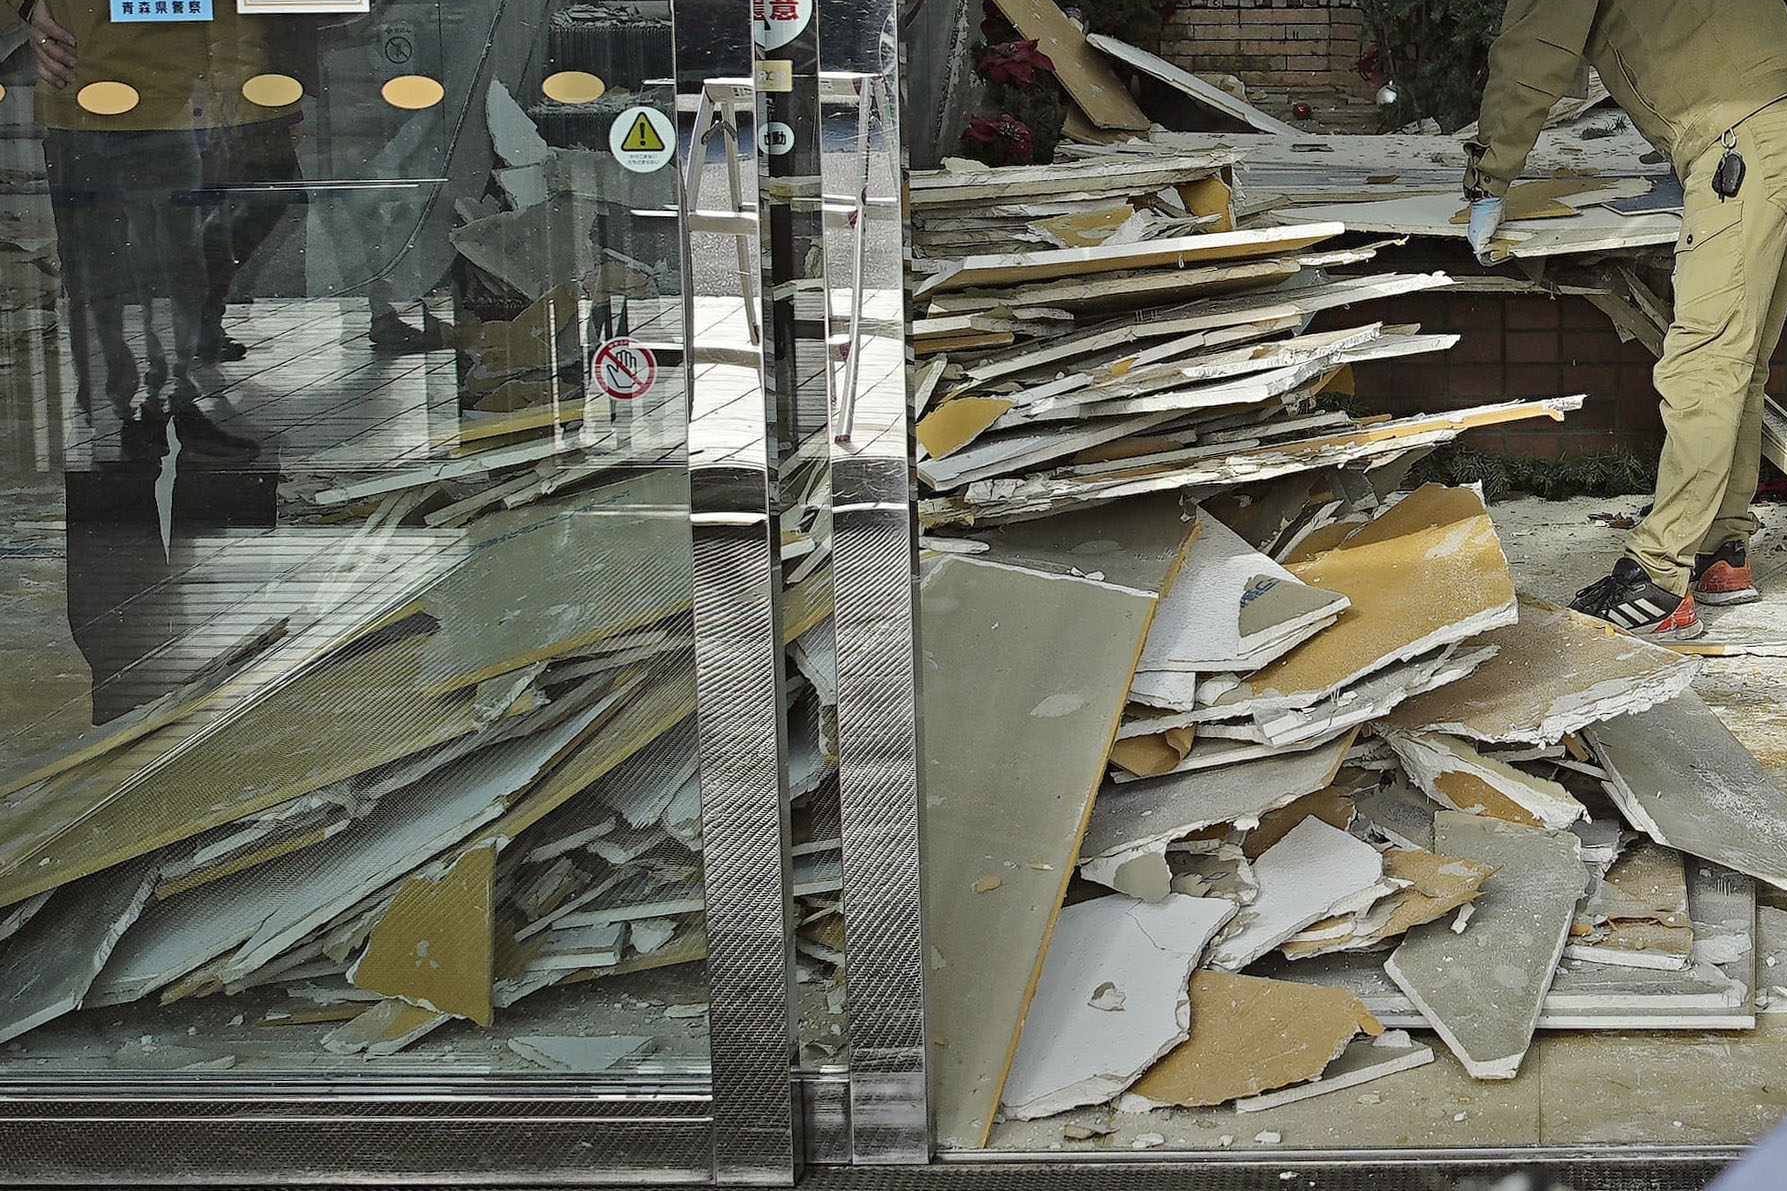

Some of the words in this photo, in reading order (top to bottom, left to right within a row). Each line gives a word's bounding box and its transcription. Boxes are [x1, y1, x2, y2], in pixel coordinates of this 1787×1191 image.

[121, 0, 202, 14] 青森県警察
